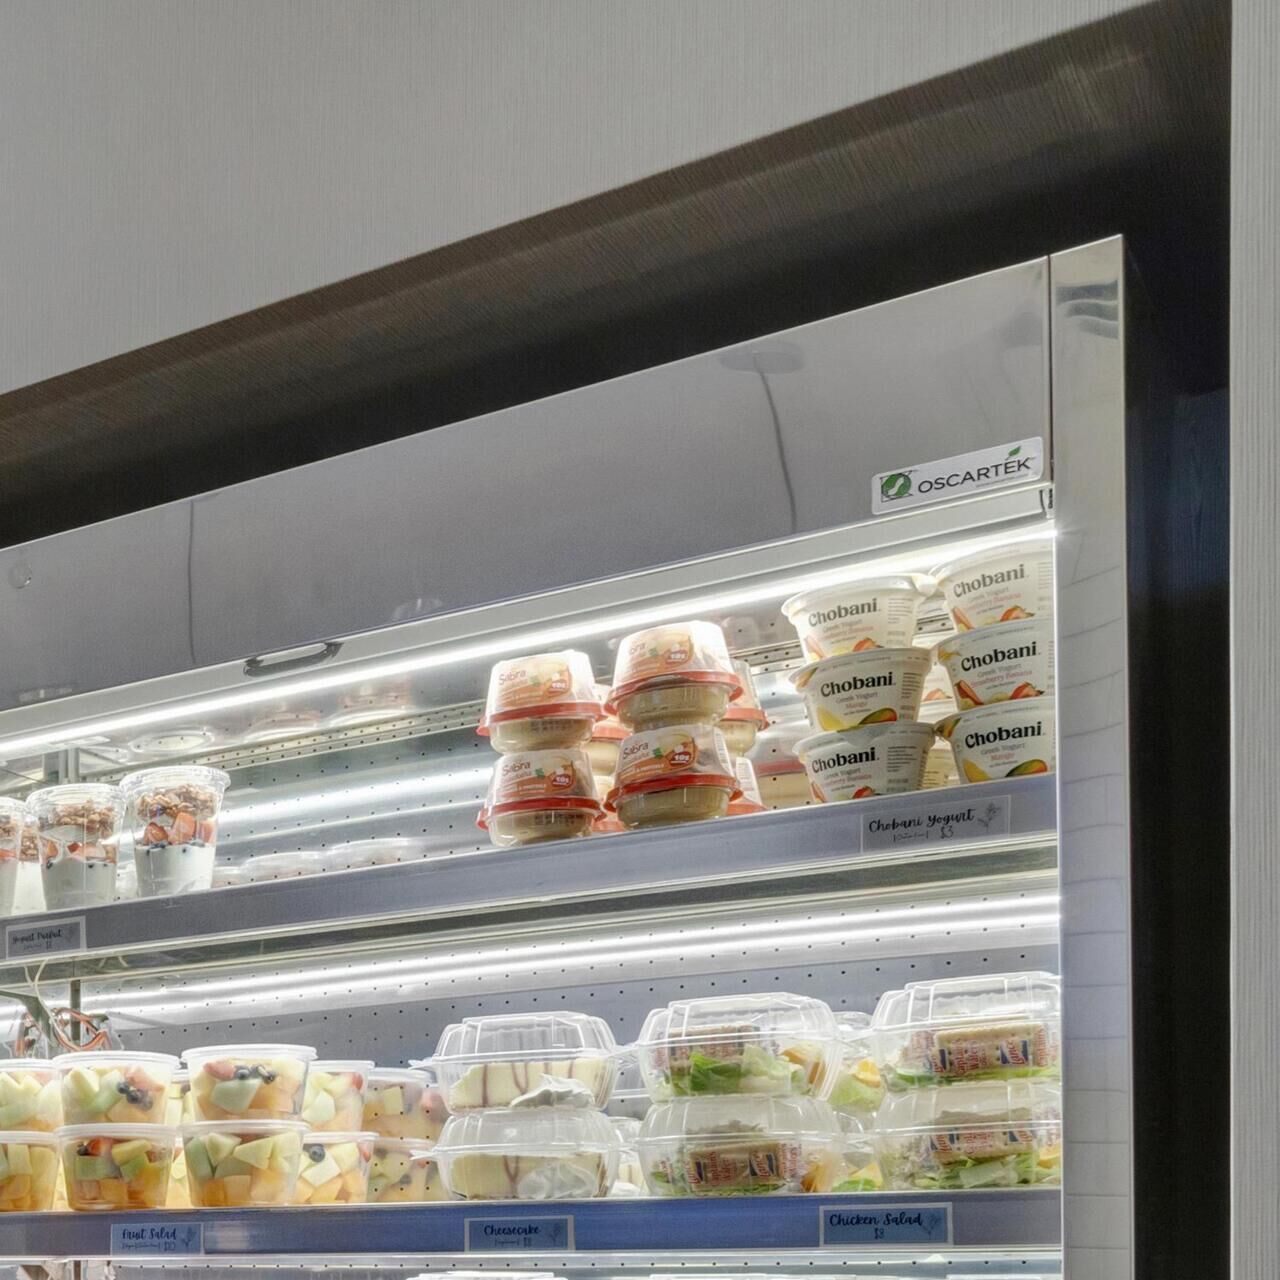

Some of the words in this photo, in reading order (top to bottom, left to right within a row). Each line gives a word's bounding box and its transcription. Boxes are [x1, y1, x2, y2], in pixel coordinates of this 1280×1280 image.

[917, 456, 1032, 494] OSCARTEK
[953, 563, 1025, 598] Chobani
[807, 597, 878, 628] Chobani
[960, 640, 1038, 672] Chobani
[820, 671, 894, 698] Chobani
[964, 720, 1042, 749] Chobani
[810, 746, 877, 774] Chobani
[868, 816, 923, 833] Chobani
[483, 1224, 541, 1236] Cheesecake
[829, 1213, 879, 1227] Chicken
[882, 1211, 923, 1226] Salad
[149, 1227, 177, 1240] Salad
